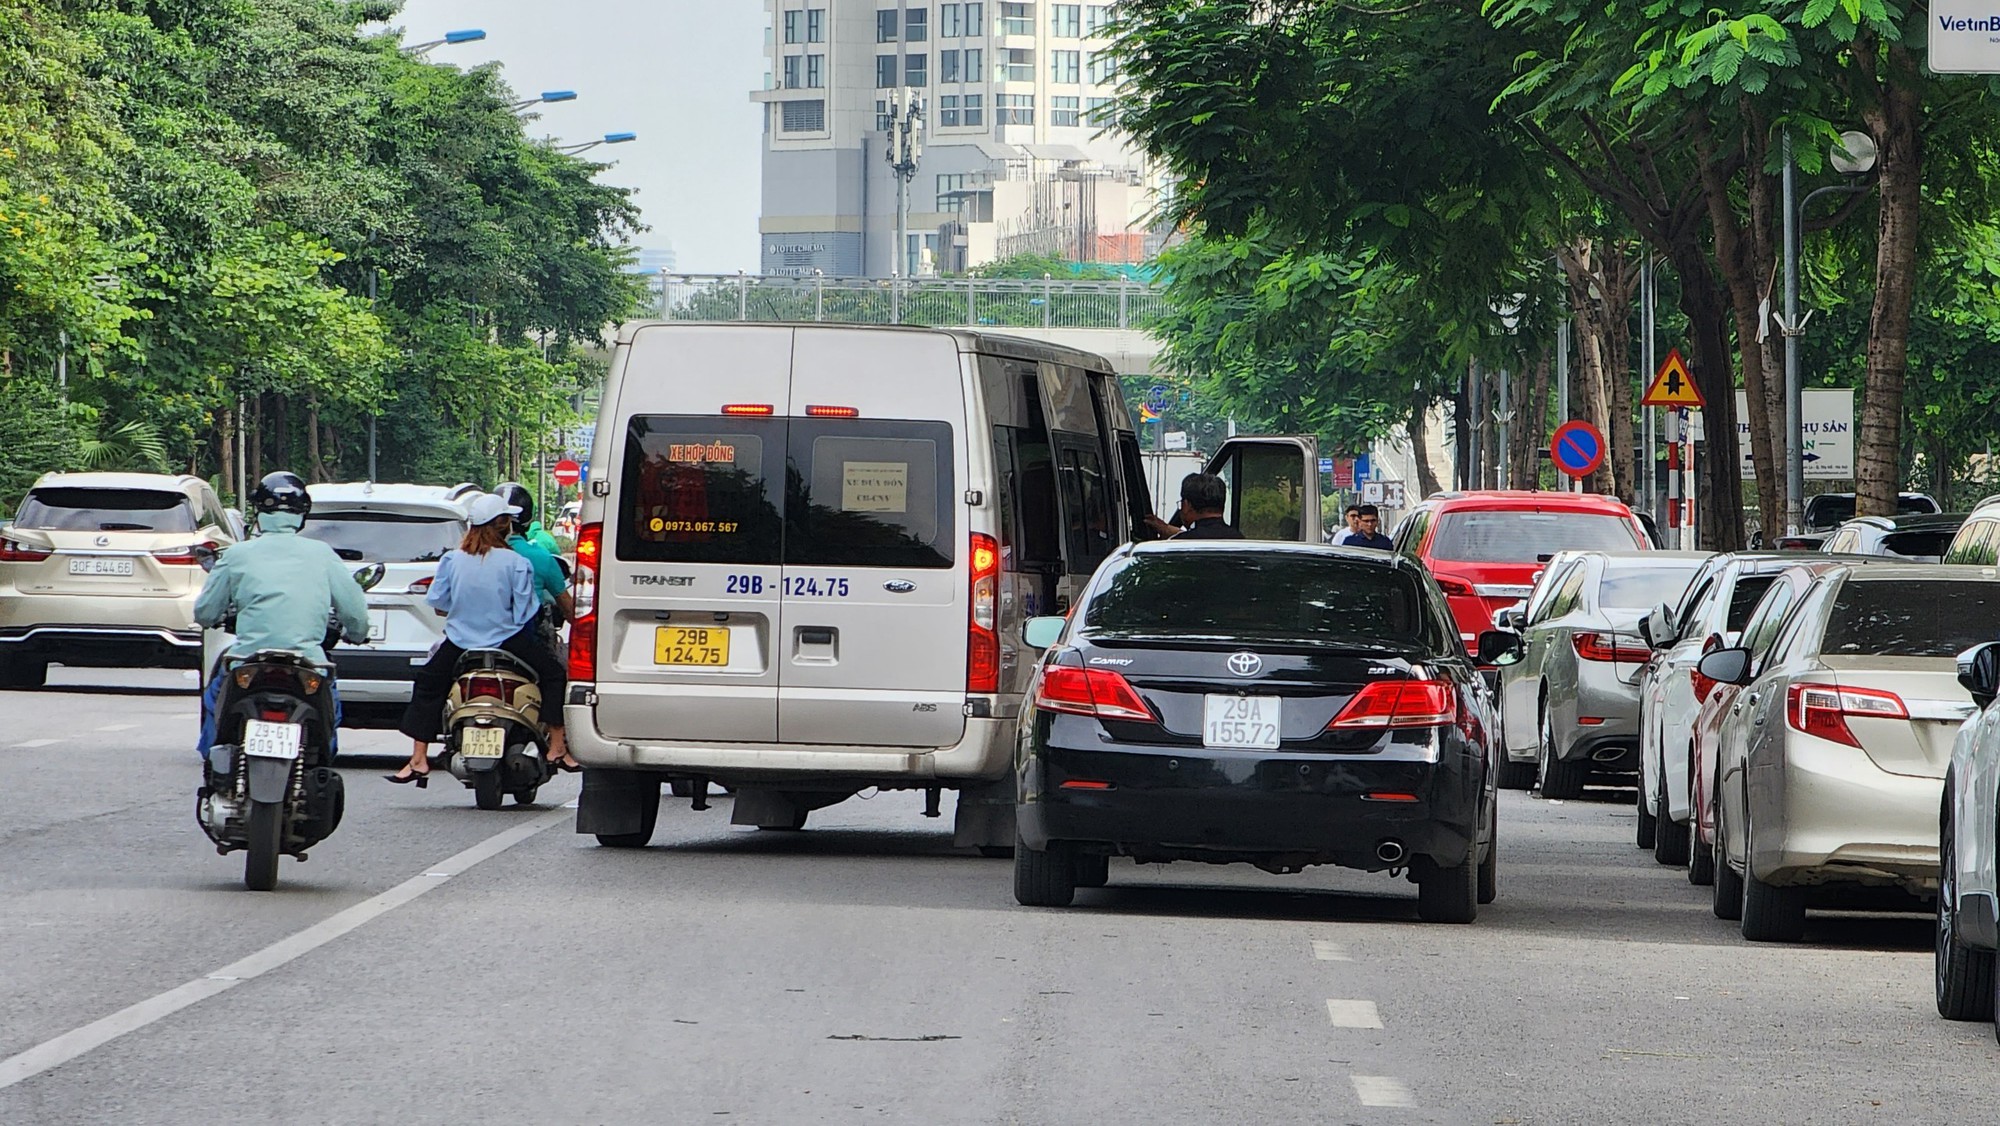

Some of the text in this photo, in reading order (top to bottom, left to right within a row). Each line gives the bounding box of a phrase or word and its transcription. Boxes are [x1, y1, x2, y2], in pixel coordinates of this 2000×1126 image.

[1802, 419, 1848, 436] HỤ SẢN
[669, 444, 684, 462] XE
[71, 560, 131, 574] 30F-644.66
[630, 574, 696, 587] TRANSIT
[726, 574, 763, 595] 29B
[783, 576, 849, 597] 124.75
[676, 629, 708, 645] 29B
[664, 647, 721, 664] 124.75
[912, 702, 938, 712] ABS
[1223, 698, 1262, 721] 29A
[255, 724, 290, 740] 29-G1
[1210, 721, 1276, 745] 155.72
[249, 738, 293, 756] 809.11
